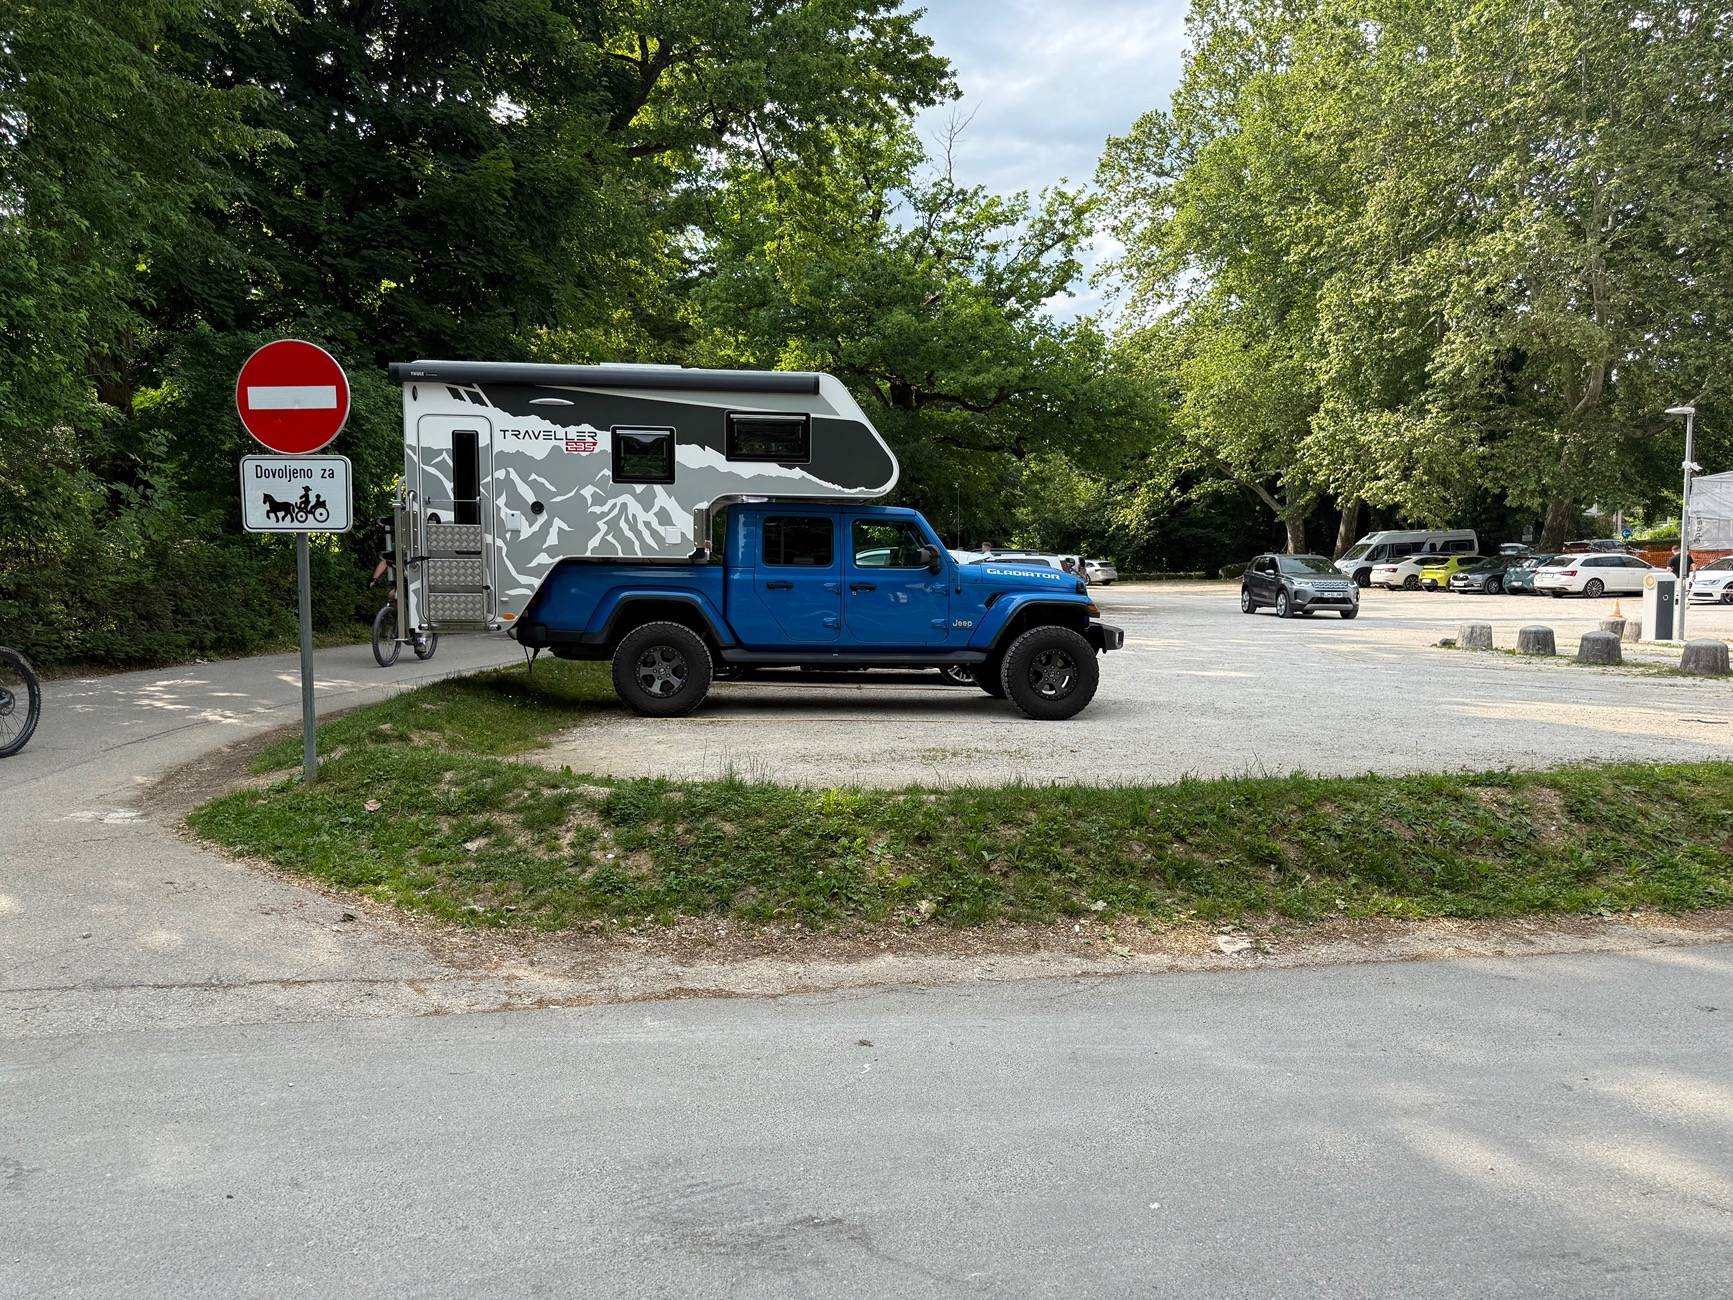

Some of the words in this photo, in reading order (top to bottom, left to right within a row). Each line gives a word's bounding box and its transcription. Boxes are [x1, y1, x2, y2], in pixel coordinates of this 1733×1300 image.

[499, 429, 598, 441] TRAVELLER
[566, 442, 595, 452] 235
[255, 464, 313, 482] Dovoljeno
[320, 468, 335, 479] za
[986, 568, 1060, 580] GLADIATOR
[952, 619, 973, 628] Jeep
